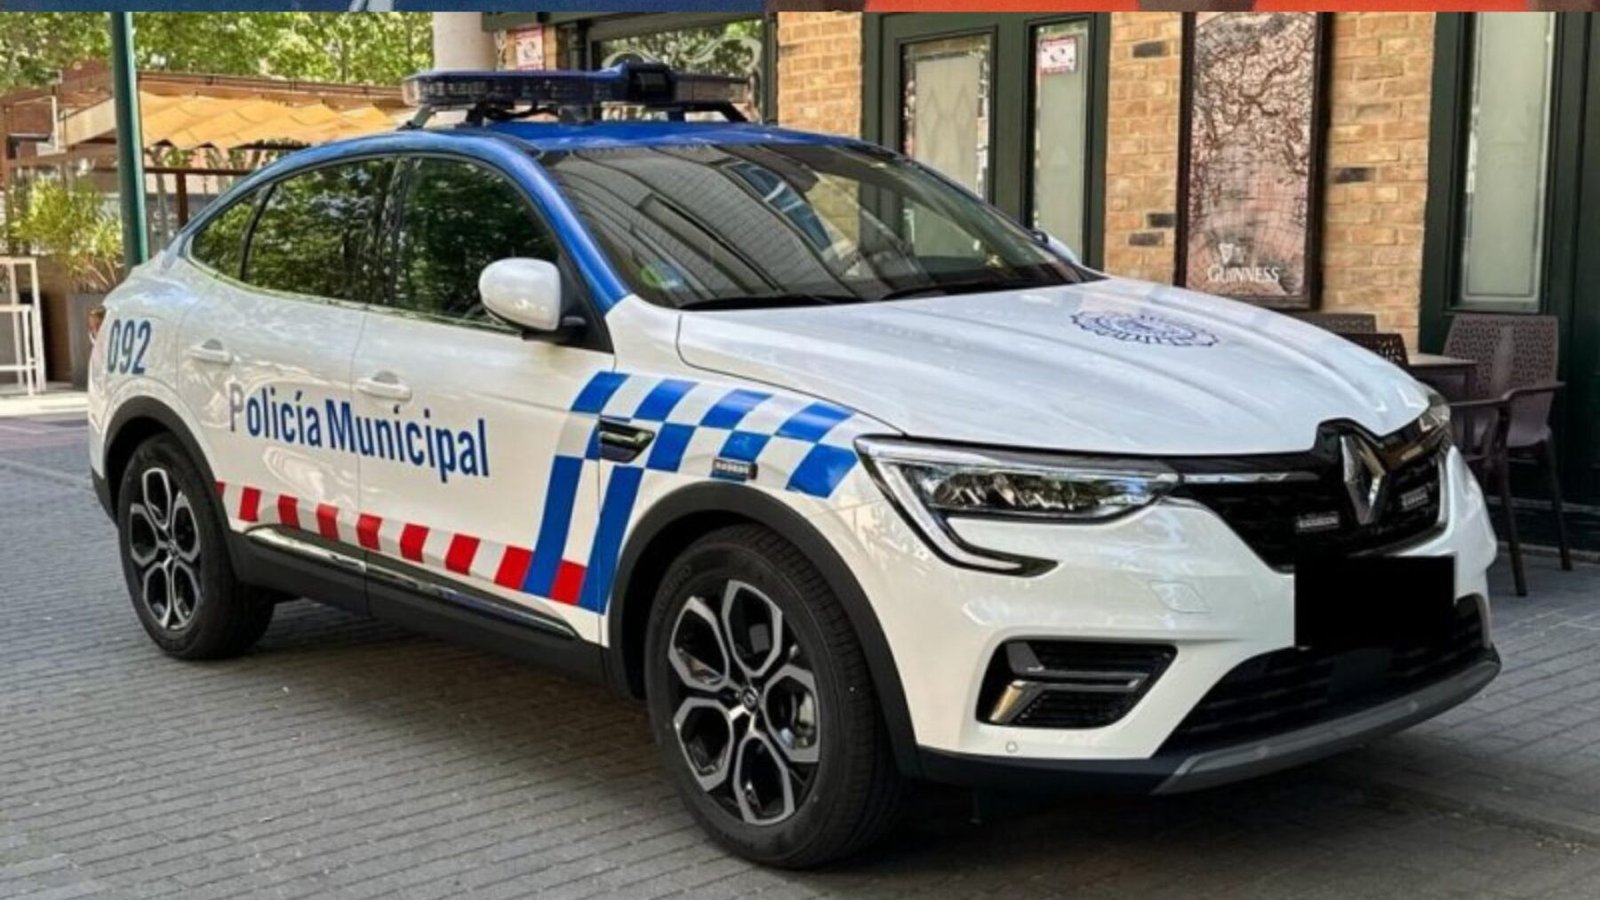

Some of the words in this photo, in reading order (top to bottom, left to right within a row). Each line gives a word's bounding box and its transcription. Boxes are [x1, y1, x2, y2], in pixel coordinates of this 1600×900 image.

[1207, 264, 1280, 283] GUINNESS
[107, 318, 151, 374] 092
[229, 383, 322, 448] Policía
[325, 399, 489, 483] Municipal
